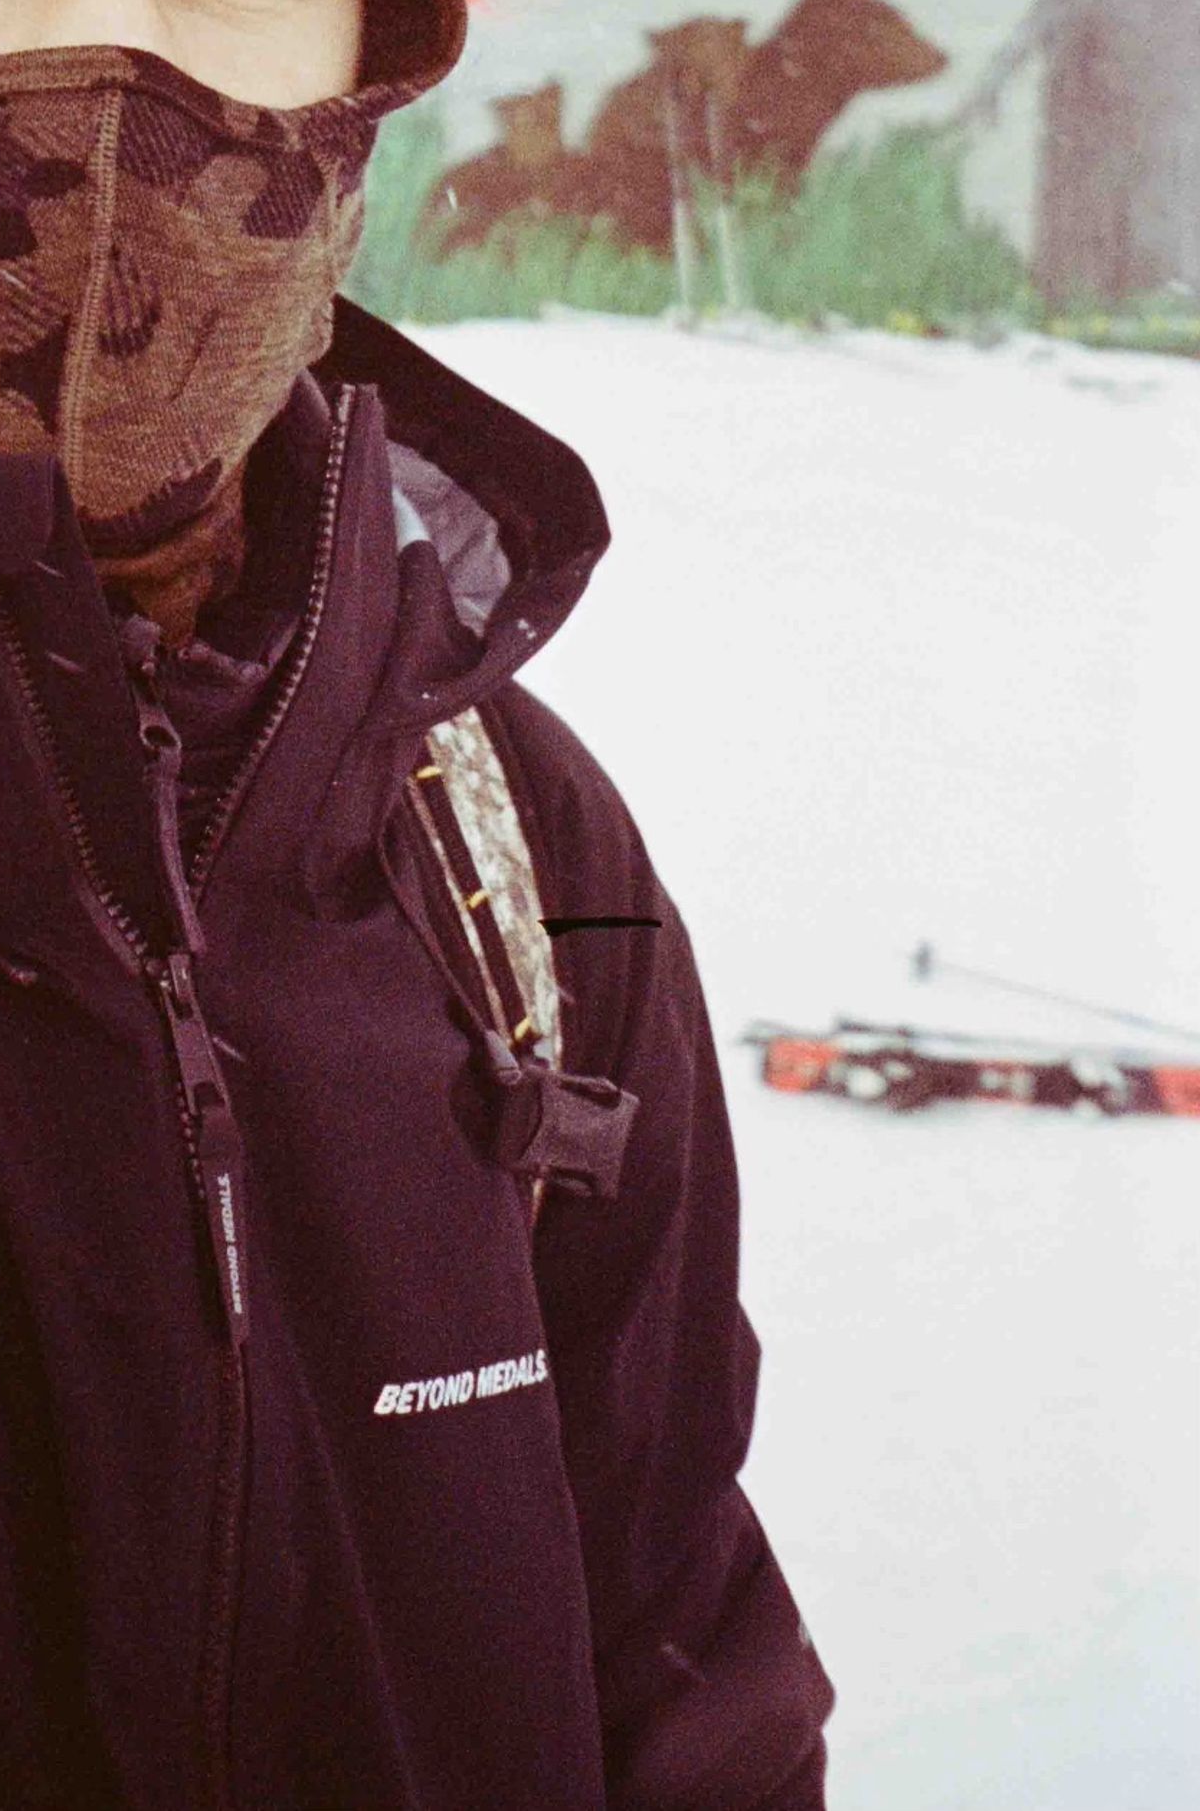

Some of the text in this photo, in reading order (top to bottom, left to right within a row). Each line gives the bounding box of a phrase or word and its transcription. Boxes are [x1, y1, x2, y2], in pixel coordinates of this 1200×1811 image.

[217, 1173, 243, 1315] BEYOND MEDALS
[374, 1349, 548, 1415] BEYOND MEDALS
